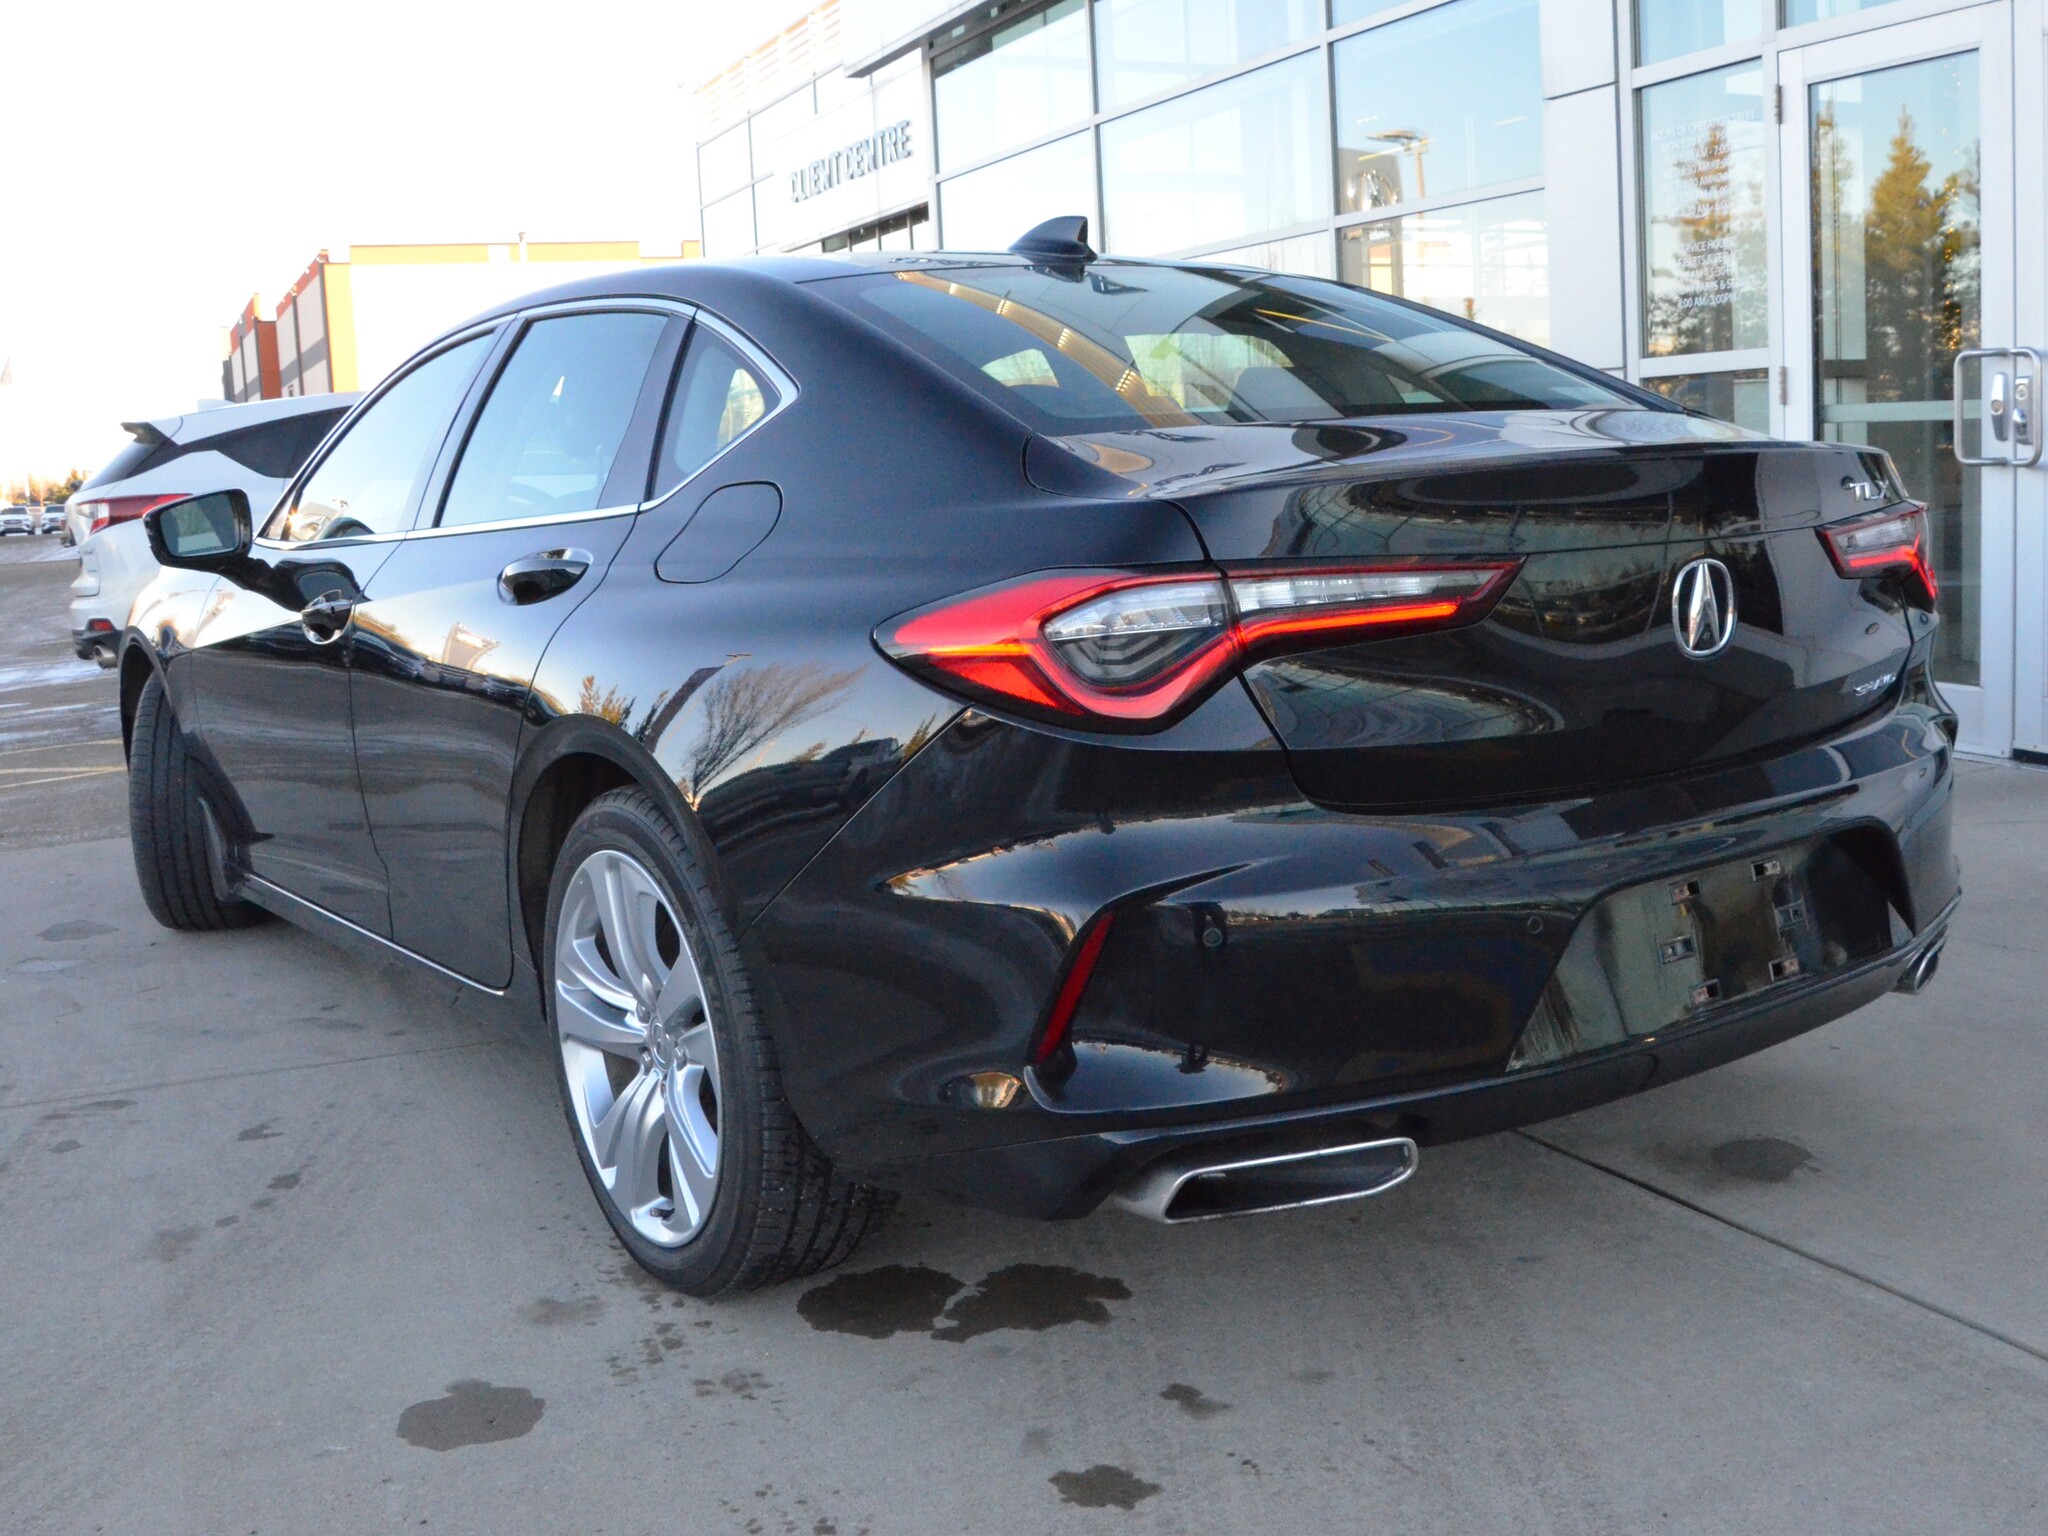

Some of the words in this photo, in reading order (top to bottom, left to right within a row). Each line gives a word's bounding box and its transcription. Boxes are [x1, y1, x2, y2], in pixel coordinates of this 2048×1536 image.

[789, 150, 842, 203] CLIENT
[843, 120, 914, 180] CENTRE
[1849, 480, 1889, 501] TLX
